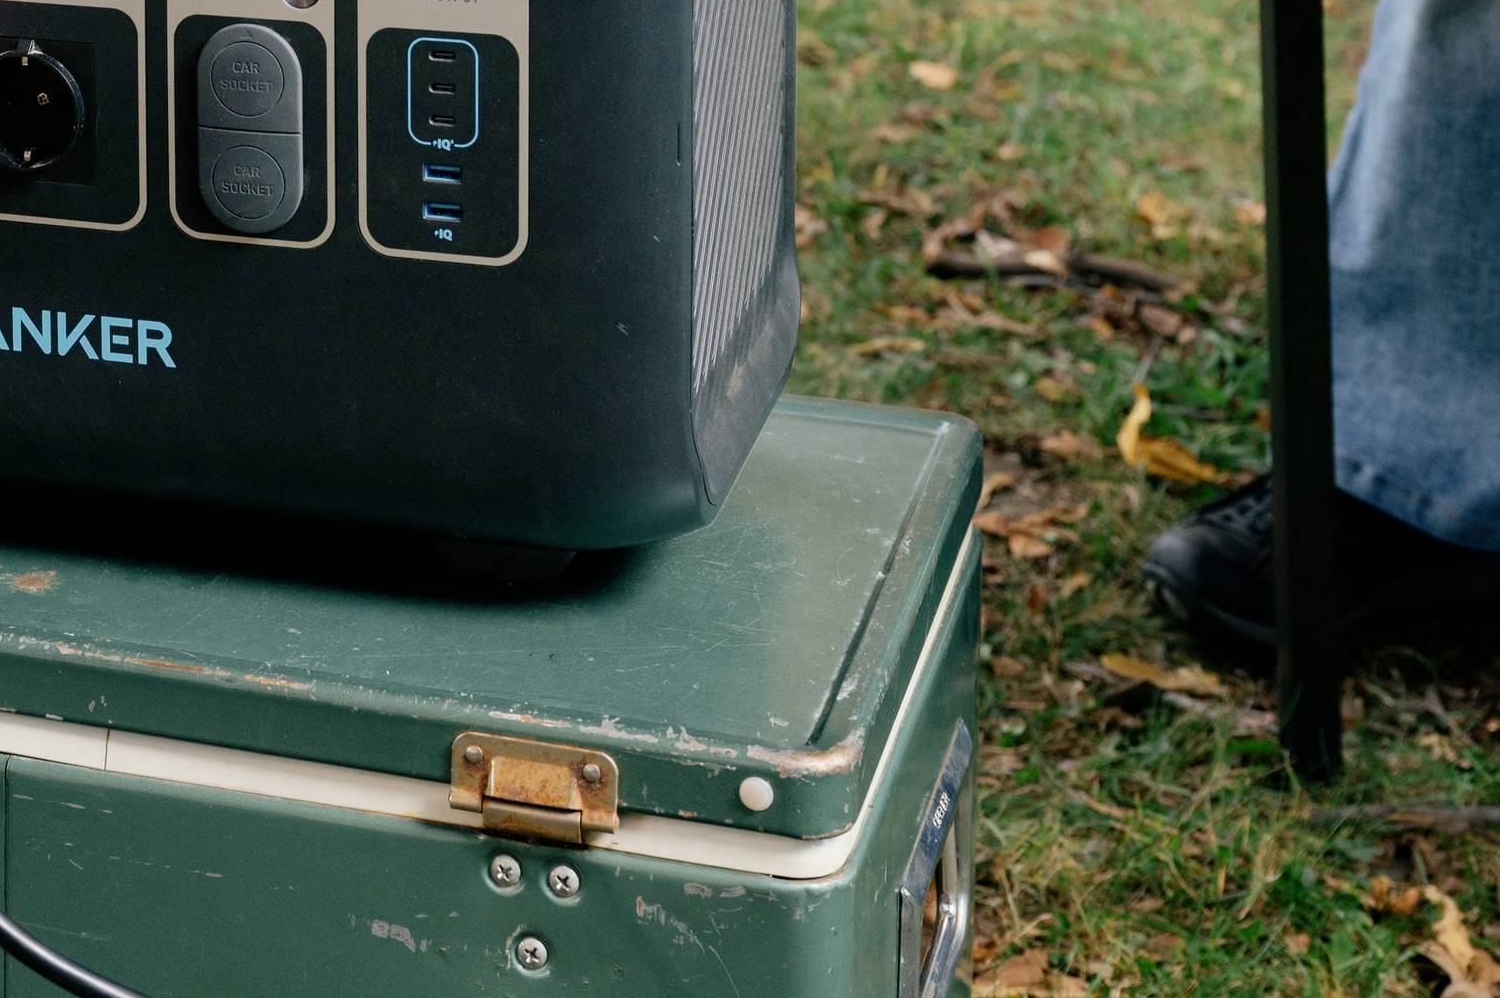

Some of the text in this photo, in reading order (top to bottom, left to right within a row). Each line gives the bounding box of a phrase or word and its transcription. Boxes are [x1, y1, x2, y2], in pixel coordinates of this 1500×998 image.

[231, 60, 260, 75] CAR
[220, 78, 274, 93] SOCKET
[233, 163, 261, 179] CAR
[221, 180, 274, 197] SOCKET
